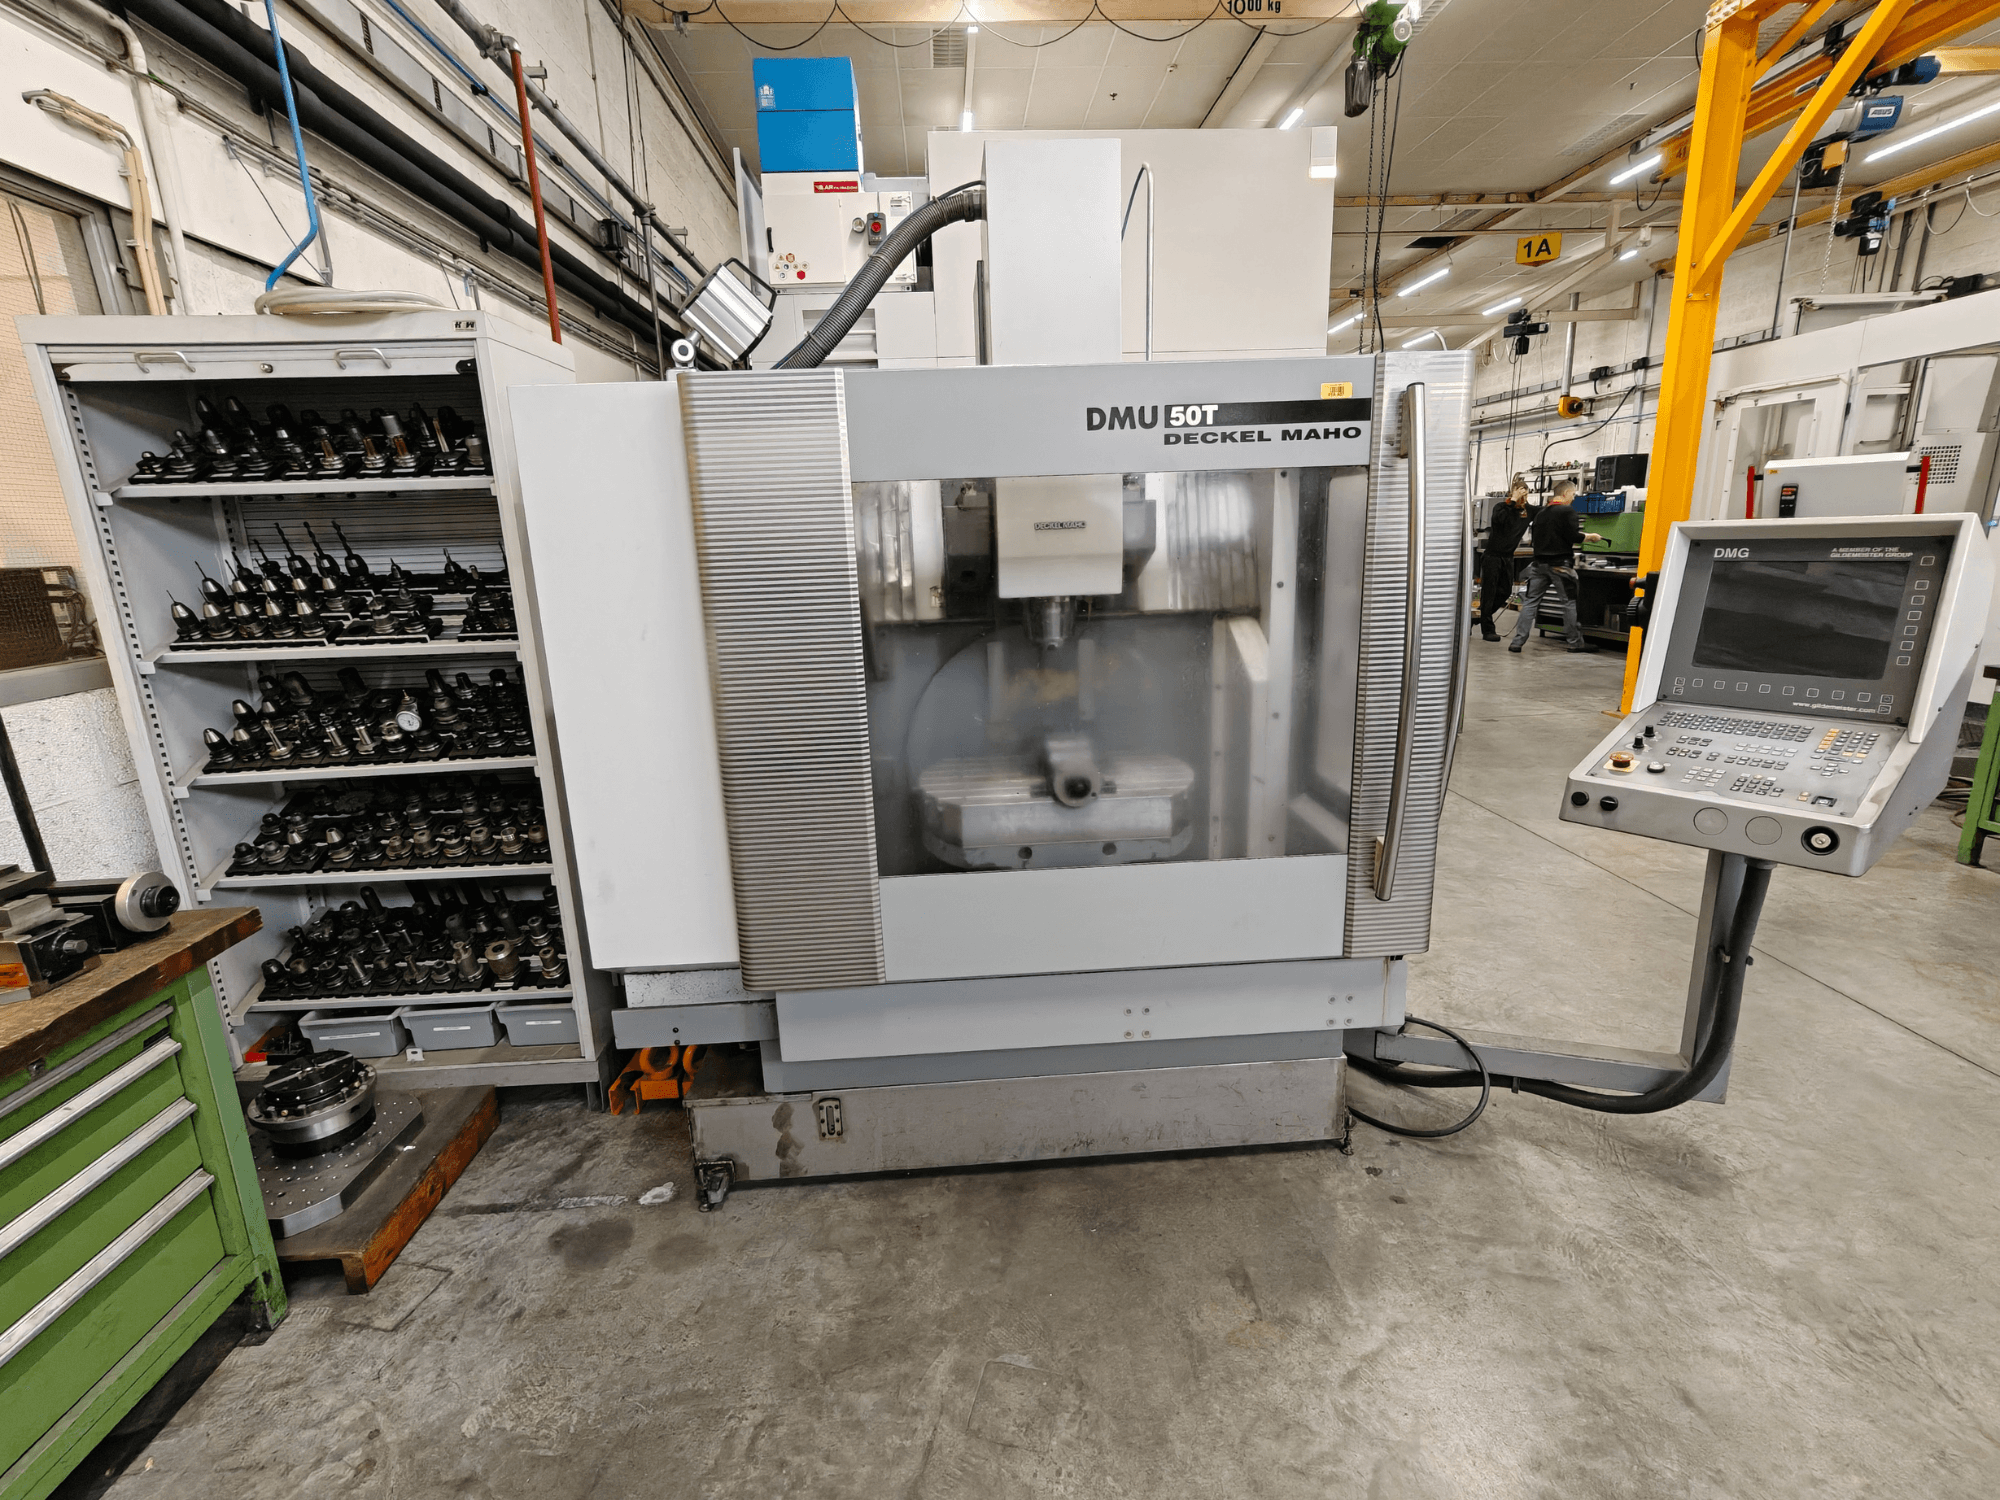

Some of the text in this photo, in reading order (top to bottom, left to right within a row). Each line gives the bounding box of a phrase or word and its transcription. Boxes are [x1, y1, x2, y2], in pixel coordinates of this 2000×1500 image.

[1227, 0, 1281, 15] 1000 kg
[1523, 238, 1552, 258] 1A
[1086, 404, 1219, 432] DMU 50T
[1163, 426, 1362, 446] DECKEL MAHO
[1713, 547, 1750, 558] DMG
[1792, 701, 1876, 714] www.gildemeister.com
